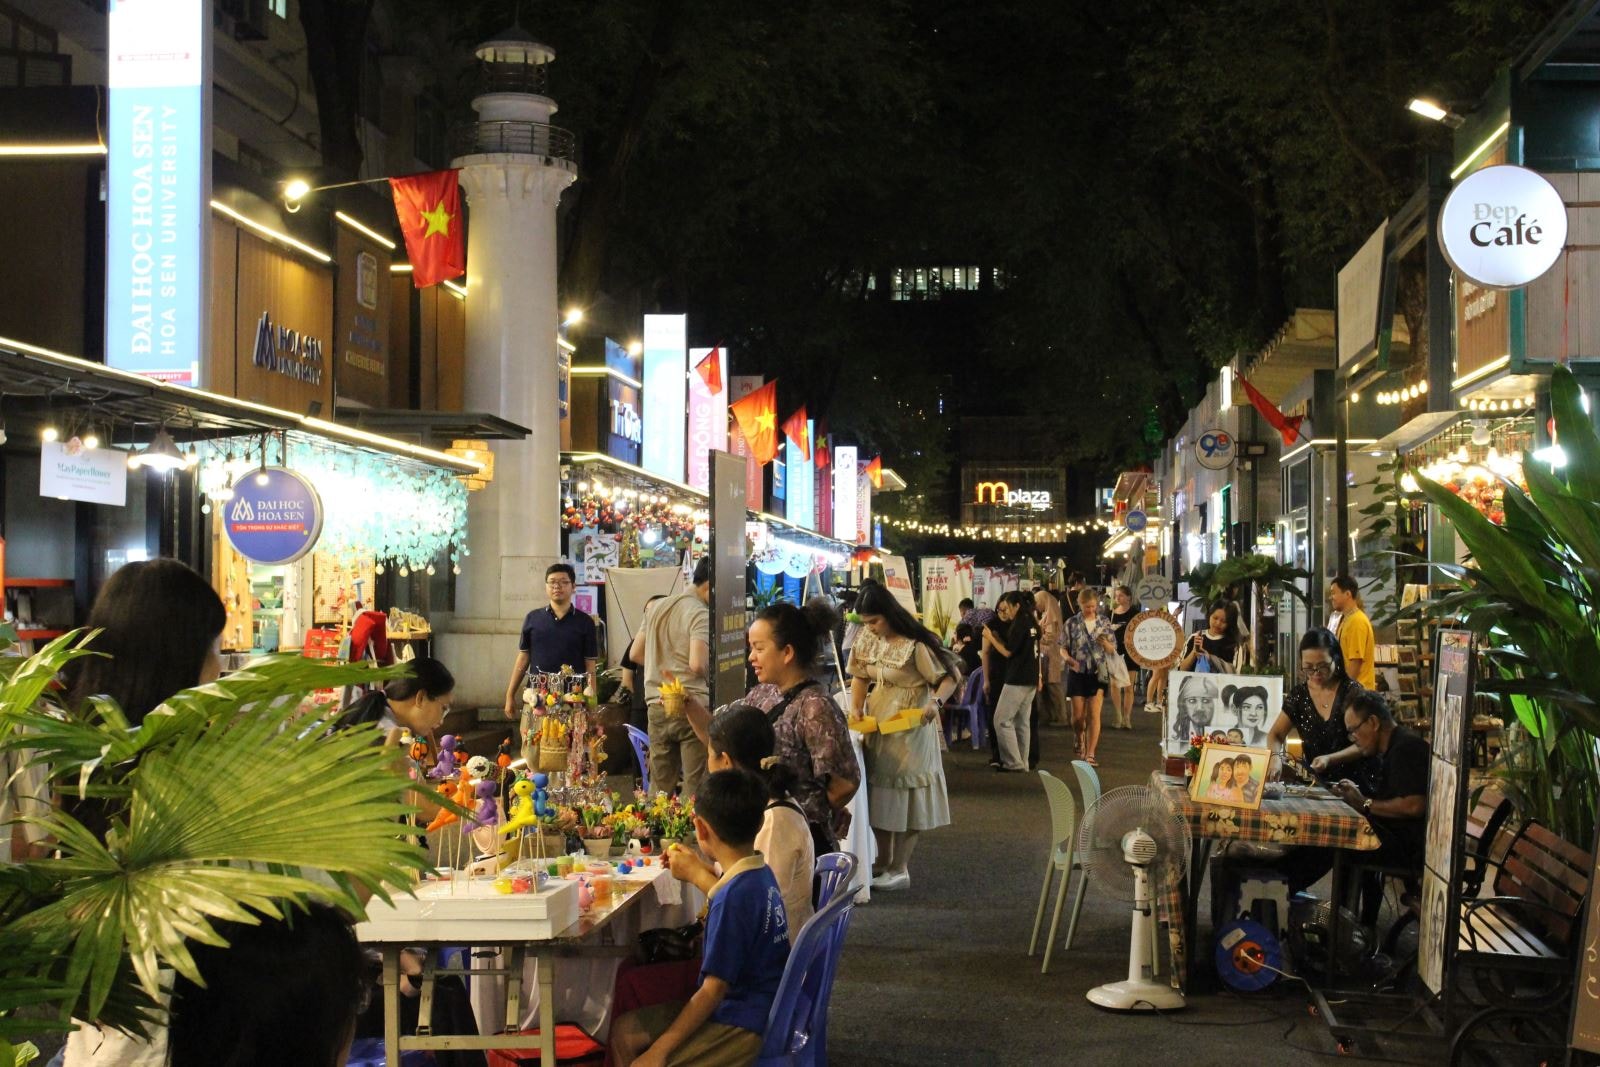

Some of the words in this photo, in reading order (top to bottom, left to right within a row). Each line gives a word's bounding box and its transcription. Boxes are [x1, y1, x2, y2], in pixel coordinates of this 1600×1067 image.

[131, 104, 155, 158] SEN
[131, 163, 154, 226] HOA
[159, 104, 177, 243] UNIVERSITY
[1469, 213, 1543, 247] Café
[1473, 202, 1518, 225] Đẹp
[131, 232, 156, 298] HỌC
[159, 253, 177, 297] SEN
[131, 302, 156, 355] ĐẠI
[159, 308, 177, 355] HOA
[257, 511, 282, 521] HOA
[283, 511, 304, 521] SEN
[1140, 584, 1172, 600] 20%
